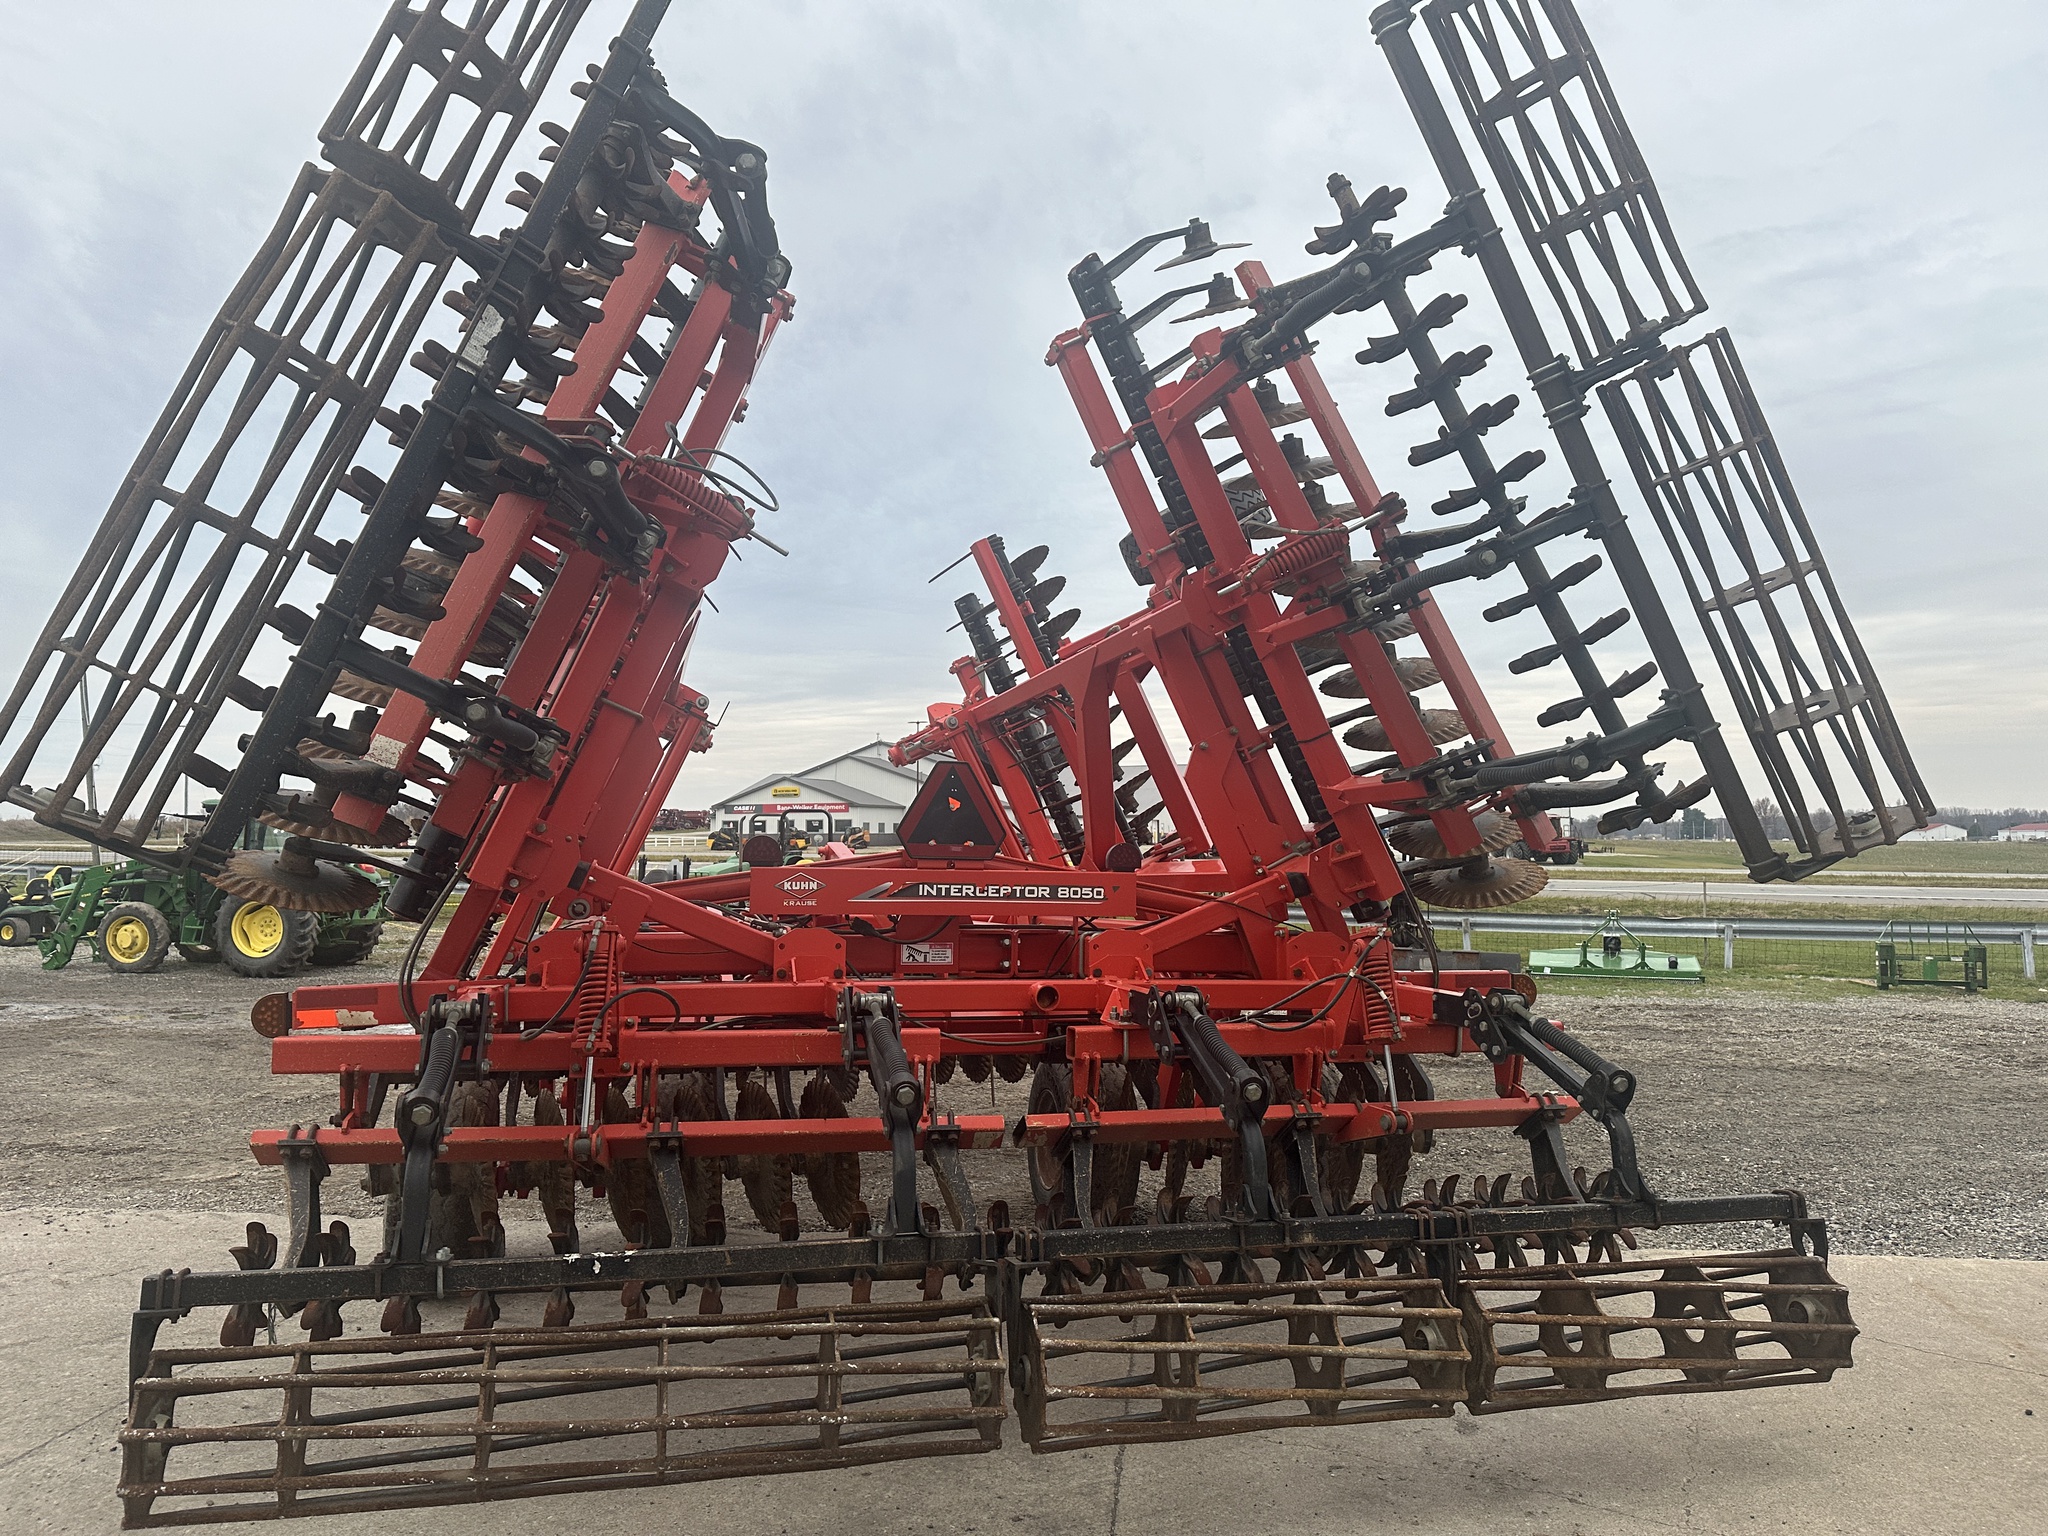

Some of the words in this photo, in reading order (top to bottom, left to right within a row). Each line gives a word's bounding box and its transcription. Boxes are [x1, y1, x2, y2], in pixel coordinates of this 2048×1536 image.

[783, 881, 818, 890] KUHN
[918, 884, 1051, 898] INTERCEPTOR
[1057, 887, 1105, 899] 8050
